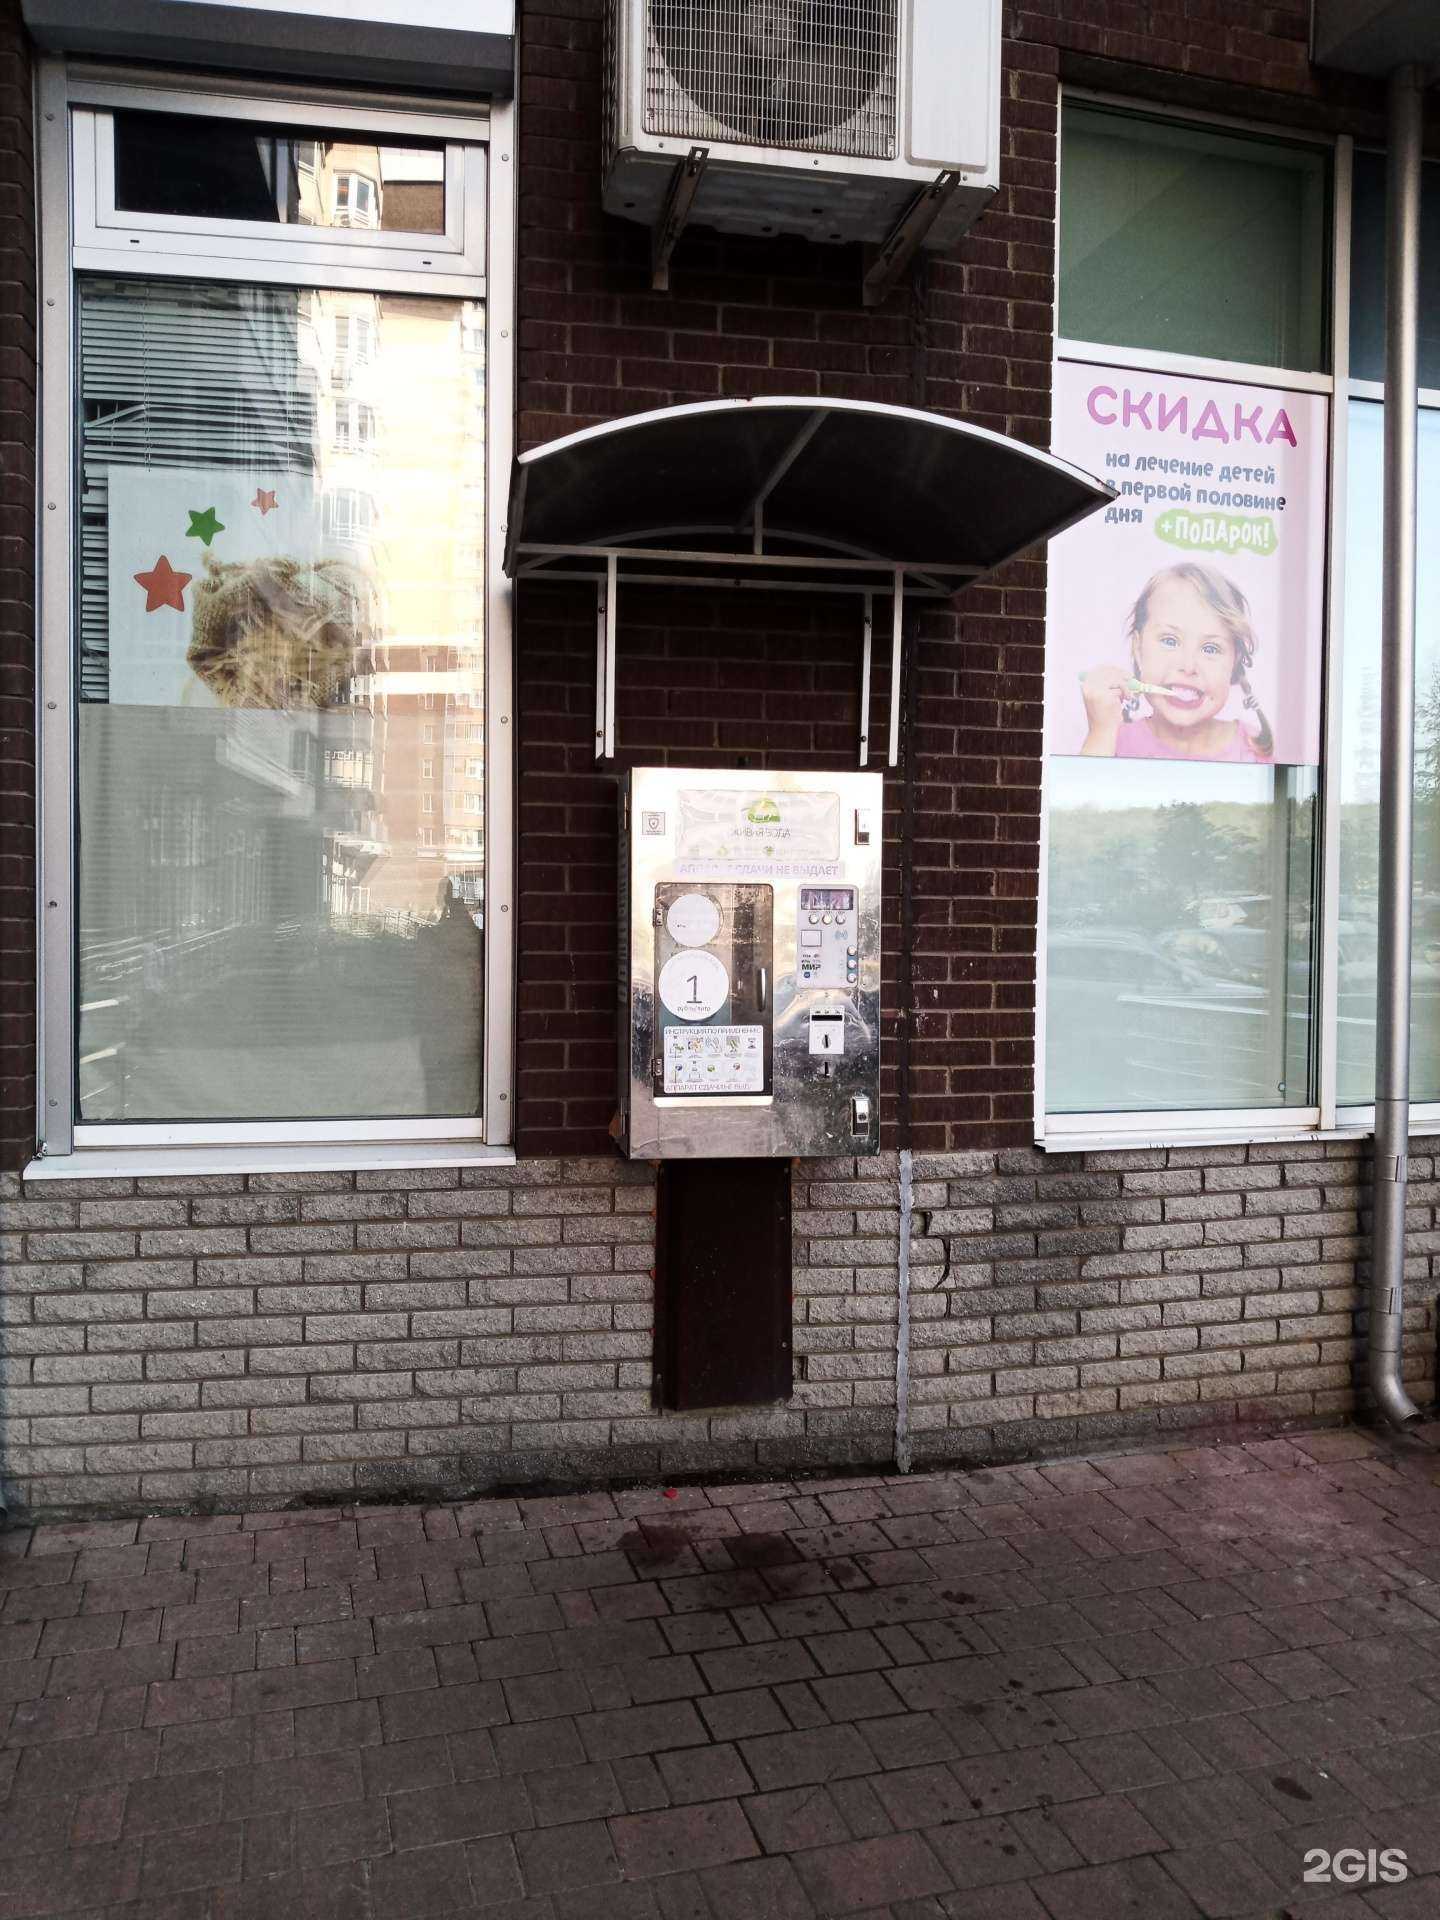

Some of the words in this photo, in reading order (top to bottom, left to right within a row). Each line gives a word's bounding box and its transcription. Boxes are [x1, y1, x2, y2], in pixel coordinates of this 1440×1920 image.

[1087, 385, 1297, 447] СКИДКА
[1105, 452, 1130, 468] на
[1135, 455, 1214, 477] лечение
[1218, 465, 1276, 485] детей
[1121, 480, 1191, 504] первой
[1196, 489, 1286, 511] половине
[1104, 506, 1143, 524] дня
[776, 865, 791, 876] НЕ
[686, 975, 703, 1004] 1
